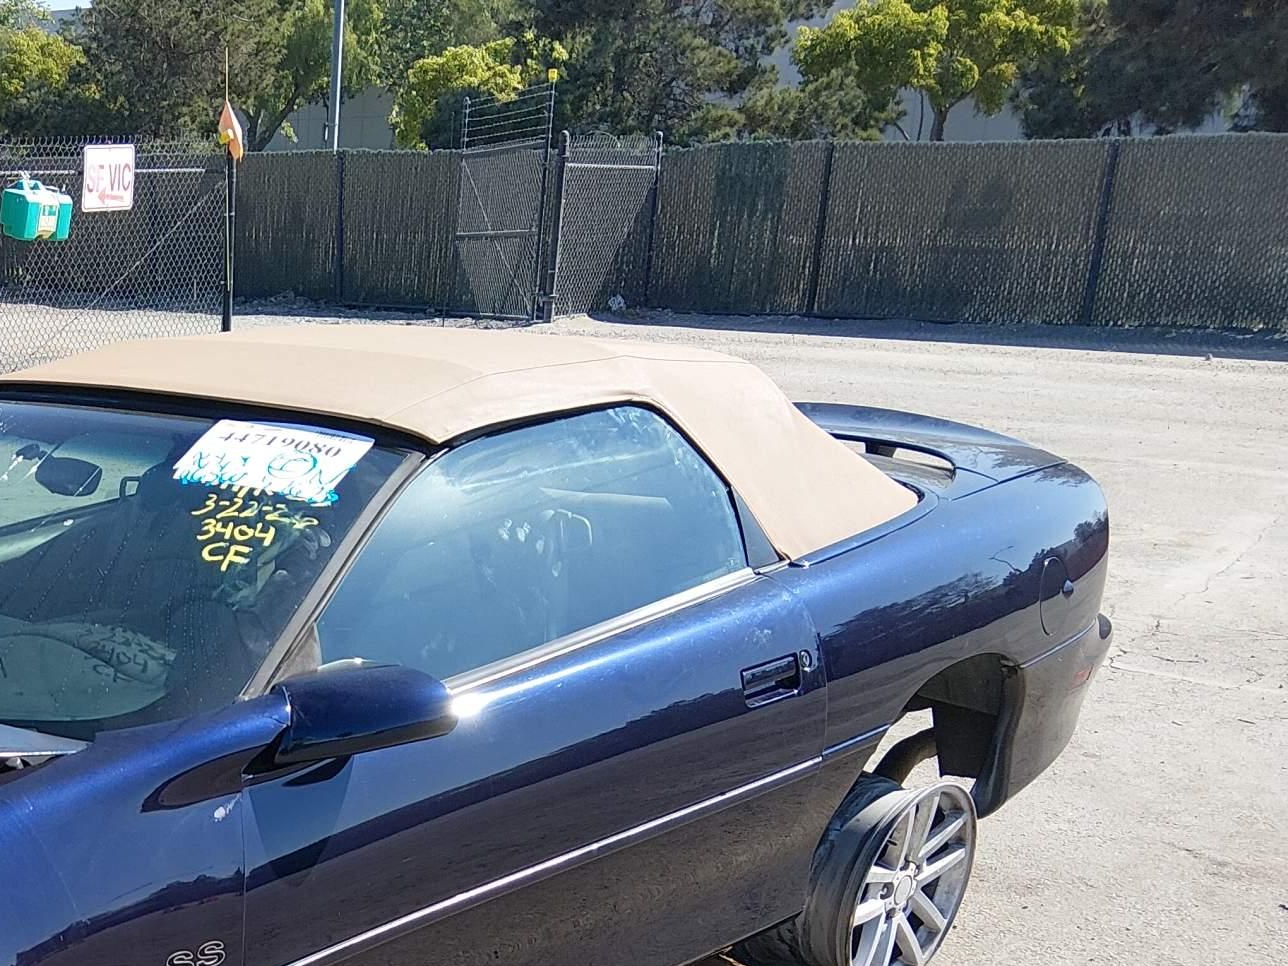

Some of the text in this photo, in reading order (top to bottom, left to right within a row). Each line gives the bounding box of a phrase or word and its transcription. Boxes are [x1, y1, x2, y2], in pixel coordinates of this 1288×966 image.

[218, 430, 343, 458] 44719080
[196, 518, 276, 547] 3404
[201, 541, 253, 572] CF
